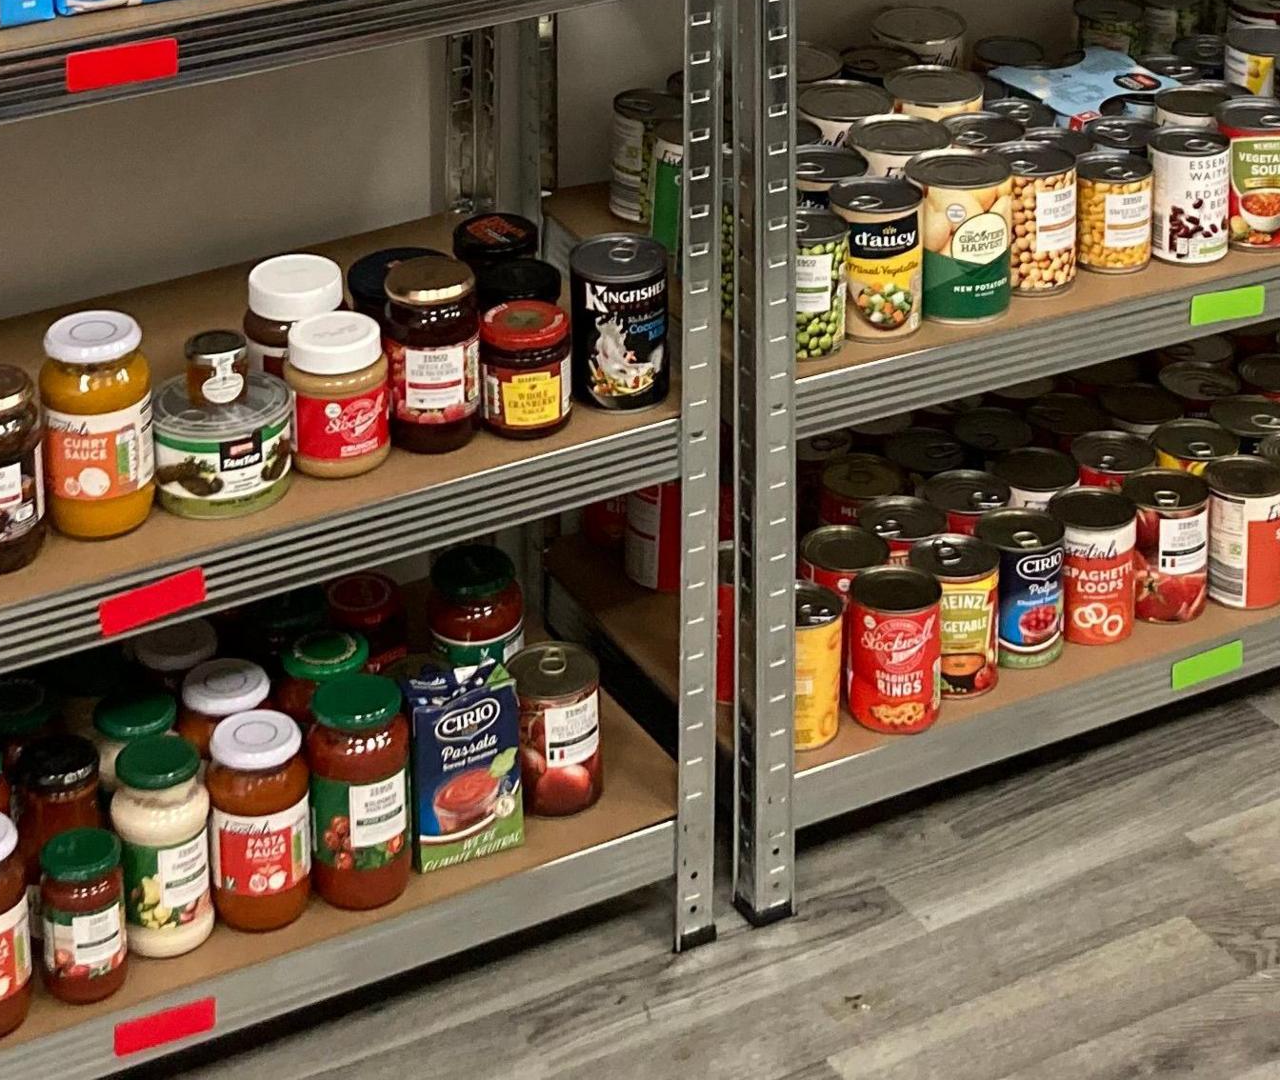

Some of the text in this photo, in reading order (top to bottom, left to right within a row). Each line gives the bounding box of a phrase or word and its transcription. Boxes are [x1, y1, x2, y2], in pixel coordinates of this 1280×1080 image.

[1185, 190, 1210, 200] RED
[855, 228, 917, 248] d'aucy
[959, 229, 1005, 244] GROWERS
[961, 240, 1004, 253] HARVEST
[953, 278, 1007, 293] NEW POTATOES
[518, 389, 548, 401] WHOLE
[63, 438, 108, 449] CURRY
[64, 449, 108, 460] SAUCE
[1023, 551, 1062, 574] CIRIO
[1077, 579, 1123, 594] LOOPS
[861, 615, 936, 651] Stockwell
[876, 680, 922, 696] RINGS
[441, 703, 494, 732] CIRIO
[441, 732, 498, 762] Passata
[247, 836, 286, 849] PASTA
[246, 844, 286, 860] SAUCE
[423, 850, 471, 872] CLIMATE
